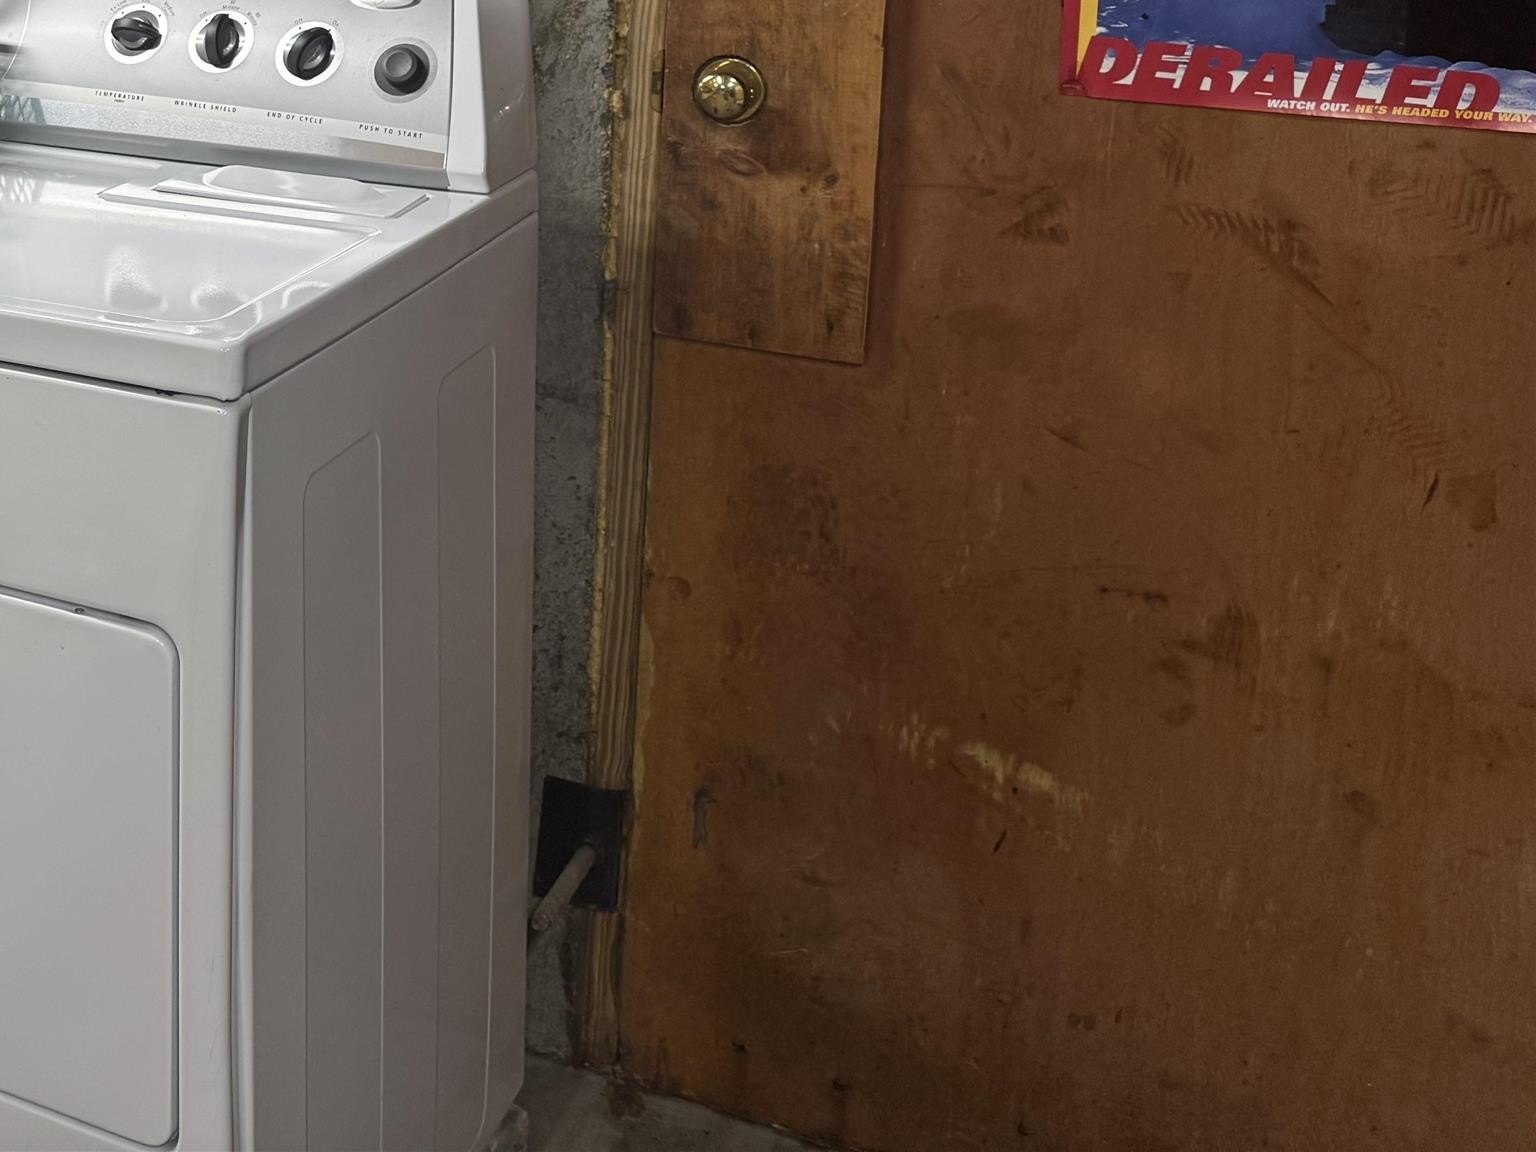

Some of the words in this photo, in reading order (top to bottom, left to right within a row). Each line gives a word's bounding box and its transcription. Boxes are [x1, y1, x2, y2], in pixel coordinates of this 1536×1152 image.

[1078, 35, 1500, 112] DERAILED
[95, 90, 145, 102] TEMPERATURE
[174, 100, 207, 110] WRINKLE
[210, 104, 238, 113] SHIELD
[1267, 98, 1315, 111] WATCH
[1320, 101, 1351, 113] OUT.
[1355, 103, 1388, 115] HE'S
[1392, 105, 1450, 118] HEADED
[1454, 109, 1494, 121] YOUR
[1498, 112, 1533, 123] WAY.
[267, 111, 282, 119] END
[299, 115, 324, 125] CYCLE
[359, 123, 380, 133] PUSH
[384, 127, 394, 135] TO
[397, 129, 424, 139] START
